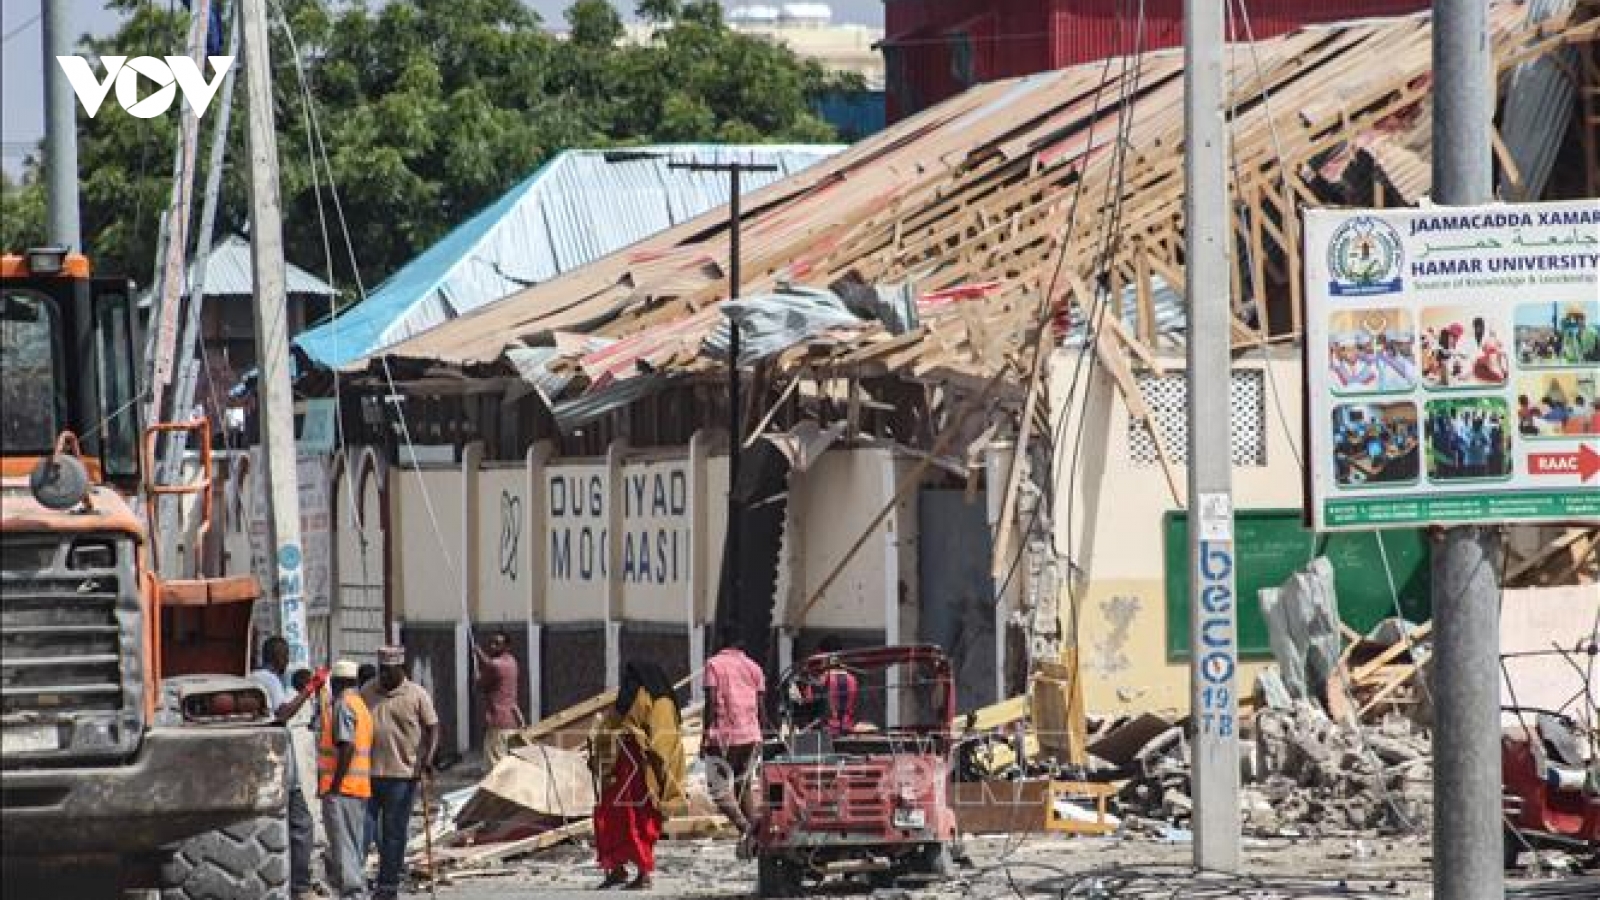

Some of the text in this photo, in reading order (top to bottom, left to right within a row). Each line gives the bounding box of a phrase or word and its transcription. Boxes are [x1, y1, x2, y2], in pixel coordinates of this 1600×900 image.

[1410, 213, 1533, 237] JAAMACADDA
[1411, 254, 1598, 277] HAMAR UNIVERSITY
[1537, 459, 1580, 471] RAAC
[1200, 541, 1234, 684] beco
[1201, 686, 1230, 709] 19
